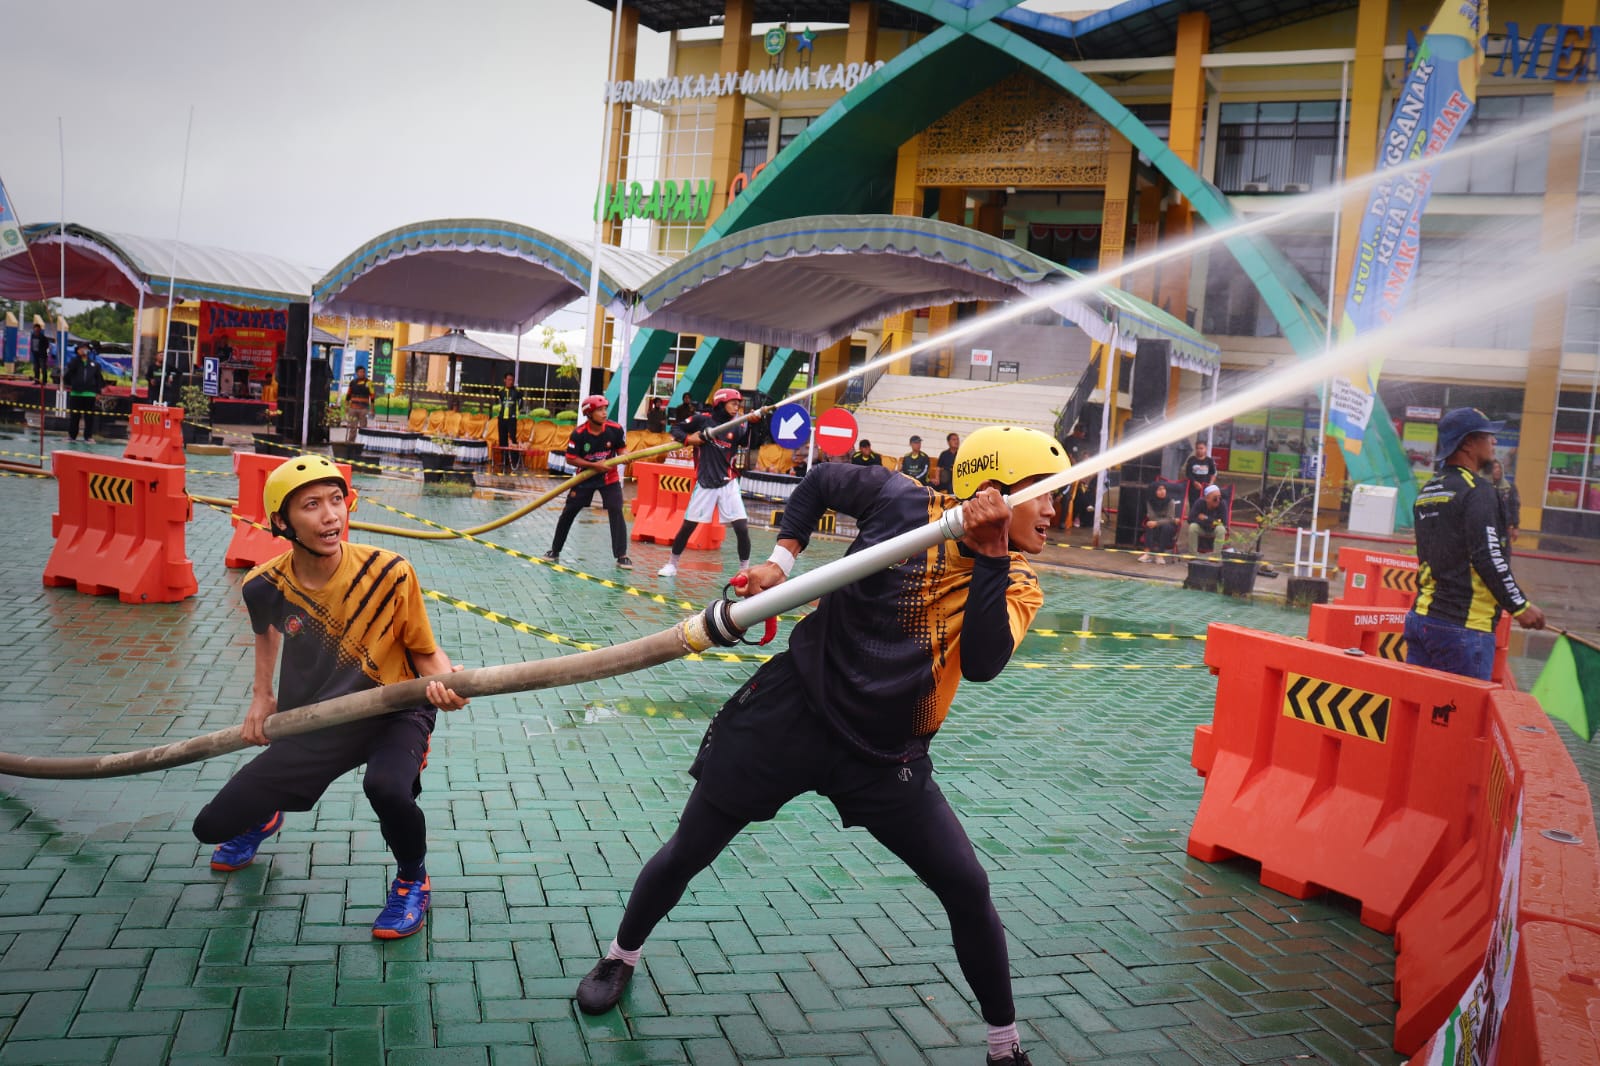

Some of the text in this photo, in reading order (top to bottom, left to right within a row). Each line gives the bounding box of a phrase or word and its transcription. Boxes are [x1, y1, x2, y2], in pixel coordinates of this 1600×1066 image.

[740, 67, 810, 95] UMUM
[1424, 91, 1470, 159] EHAT
[1376, 206, 1408, 266] KITA
[1383, 240, 1419, 307] ANAK
[1354, 615, 1379, 625] DINAS
